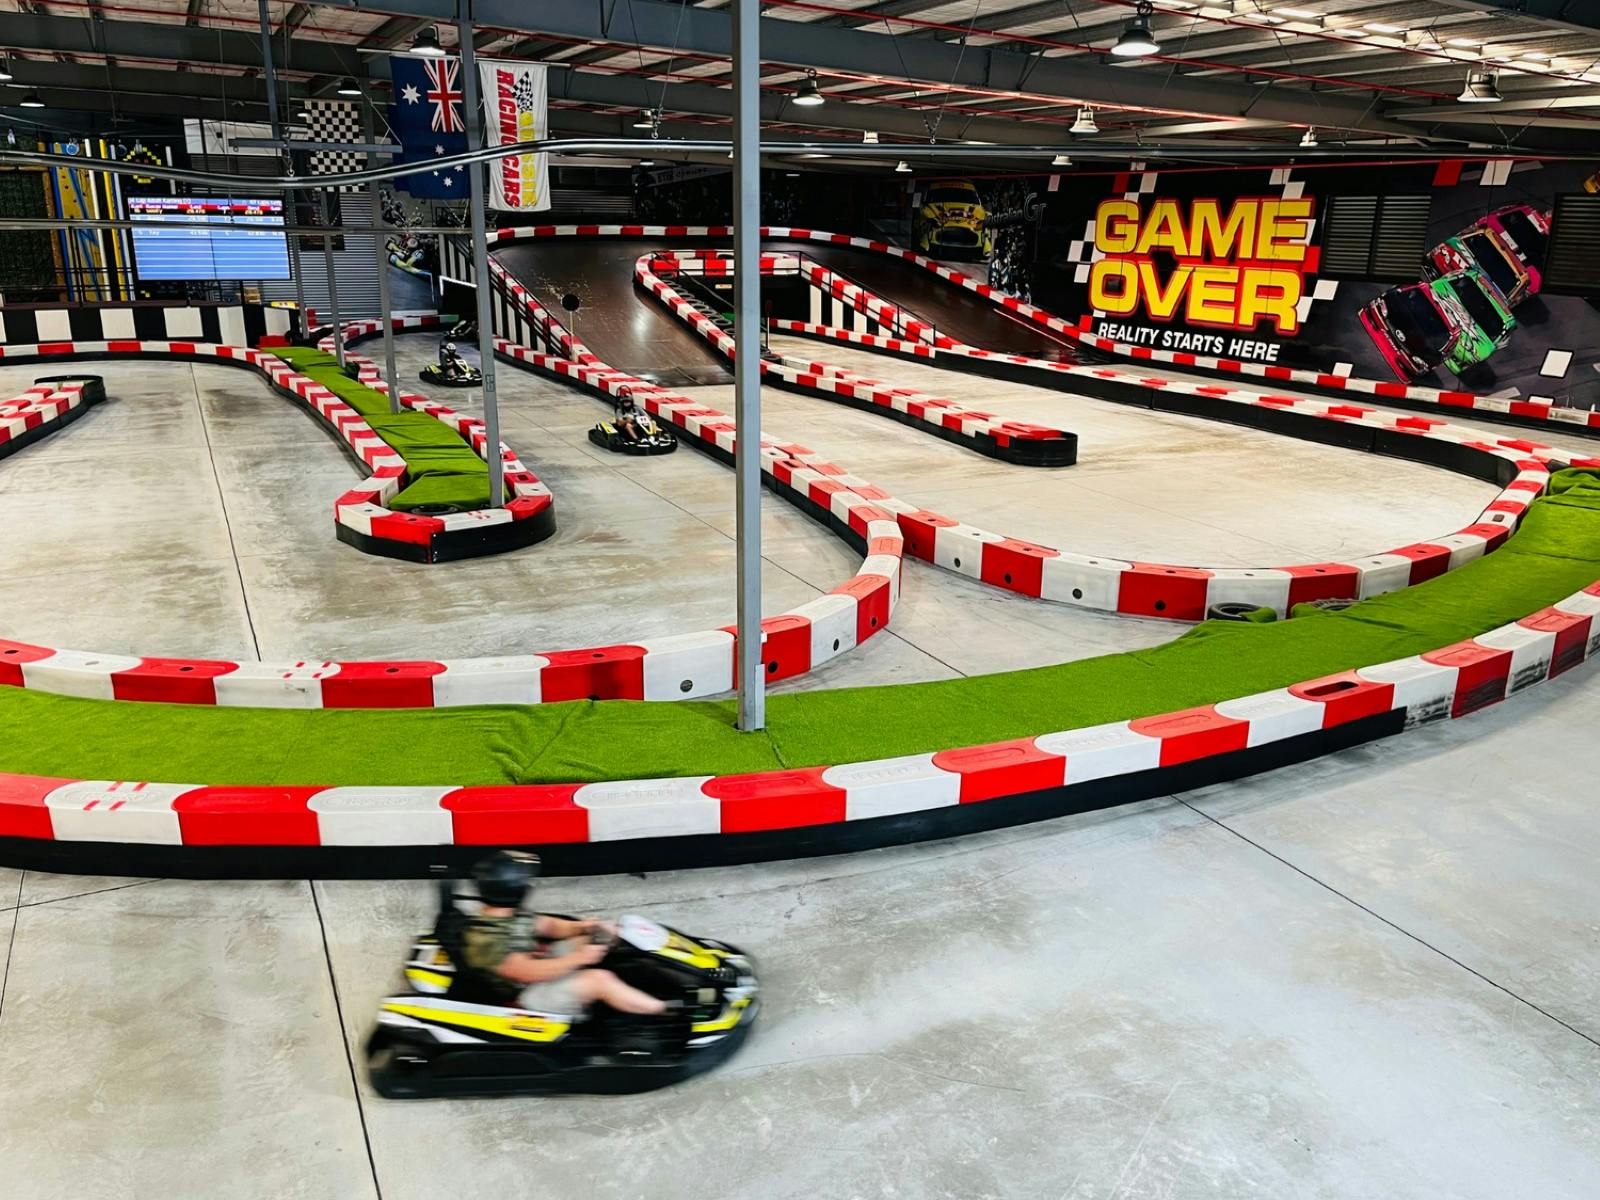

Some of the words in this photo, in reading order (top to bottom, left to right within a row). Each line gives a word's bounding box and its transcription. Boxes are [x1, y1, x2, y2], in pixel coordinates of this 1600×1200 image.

[496, 69, 519, 146] RACING
[502, 154, 520, 208] CARS
[1095, 199, 1313, 262] GAME
[1090, 259, 1301, 331] OVER
[1098, 322, 1159, 345] REALITY
[1162, 331, 1224, 354] STARTS
[1228, 338, 1280, 361] HERE
